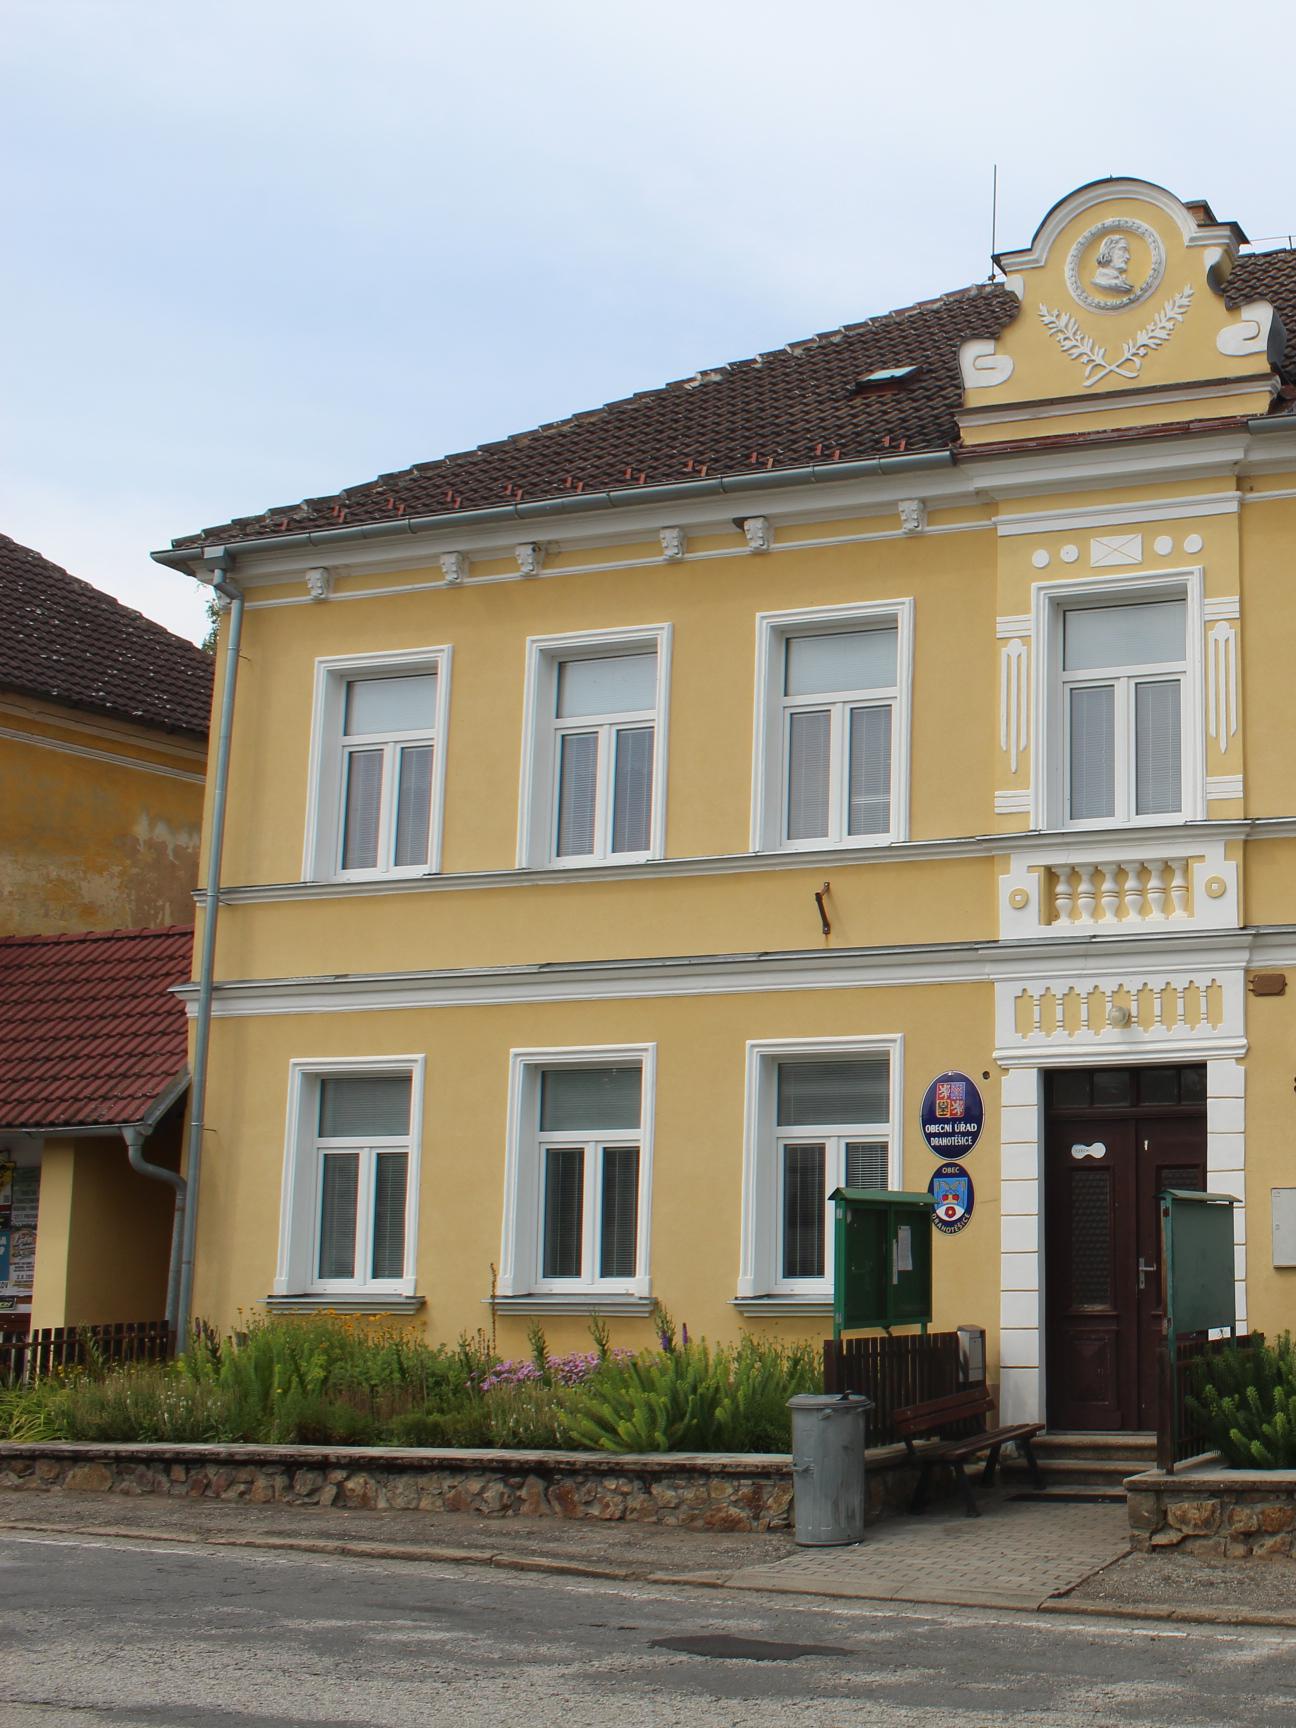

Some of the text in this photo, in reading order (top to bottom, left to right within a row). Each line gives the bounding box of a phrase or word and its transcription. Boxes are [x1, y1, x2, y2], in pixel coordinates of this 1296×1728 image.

[925, 1121, 978, 1133] OBECNÍ ÚŘAD
[930, 1134, 973, 1146] DRAHOTĚŠICE
